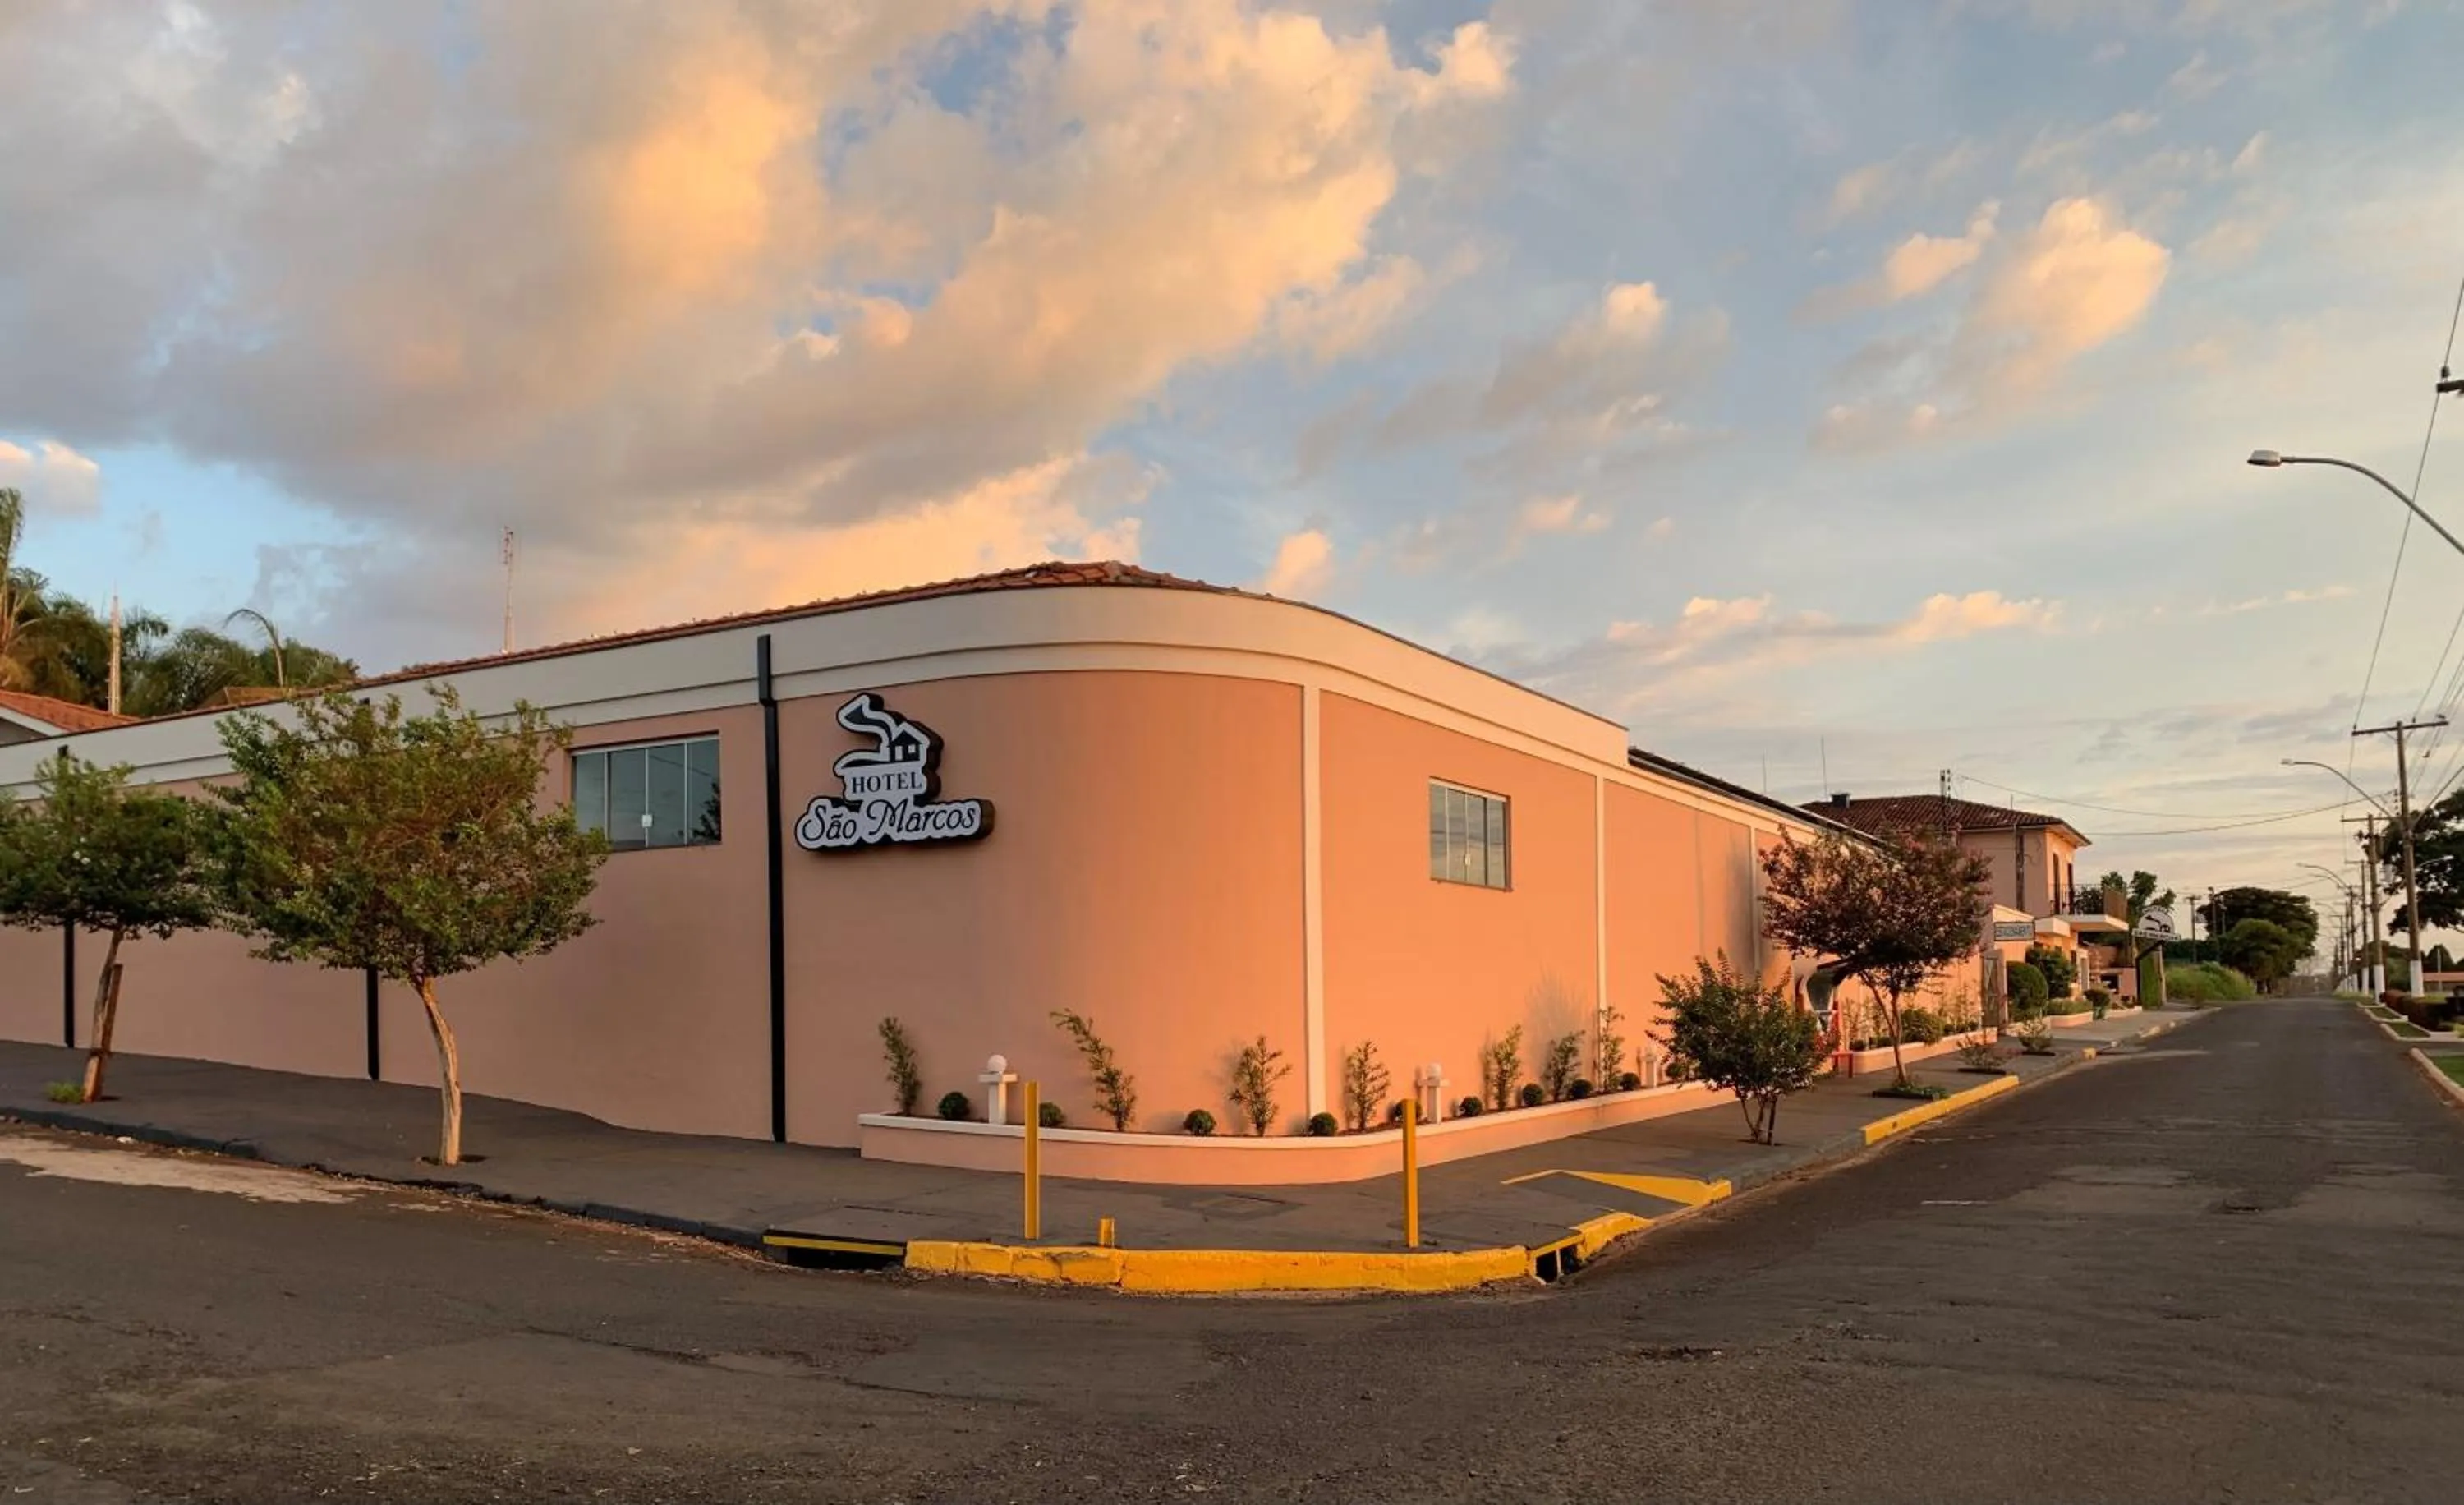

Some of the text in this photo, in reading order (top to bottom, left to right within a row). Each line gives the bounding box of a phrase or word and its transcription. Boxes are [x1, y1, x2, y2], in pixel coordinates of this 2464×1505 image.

[852, 771, 922, 794] HOTEL
[802, 798, 975, 841] São Marcos
